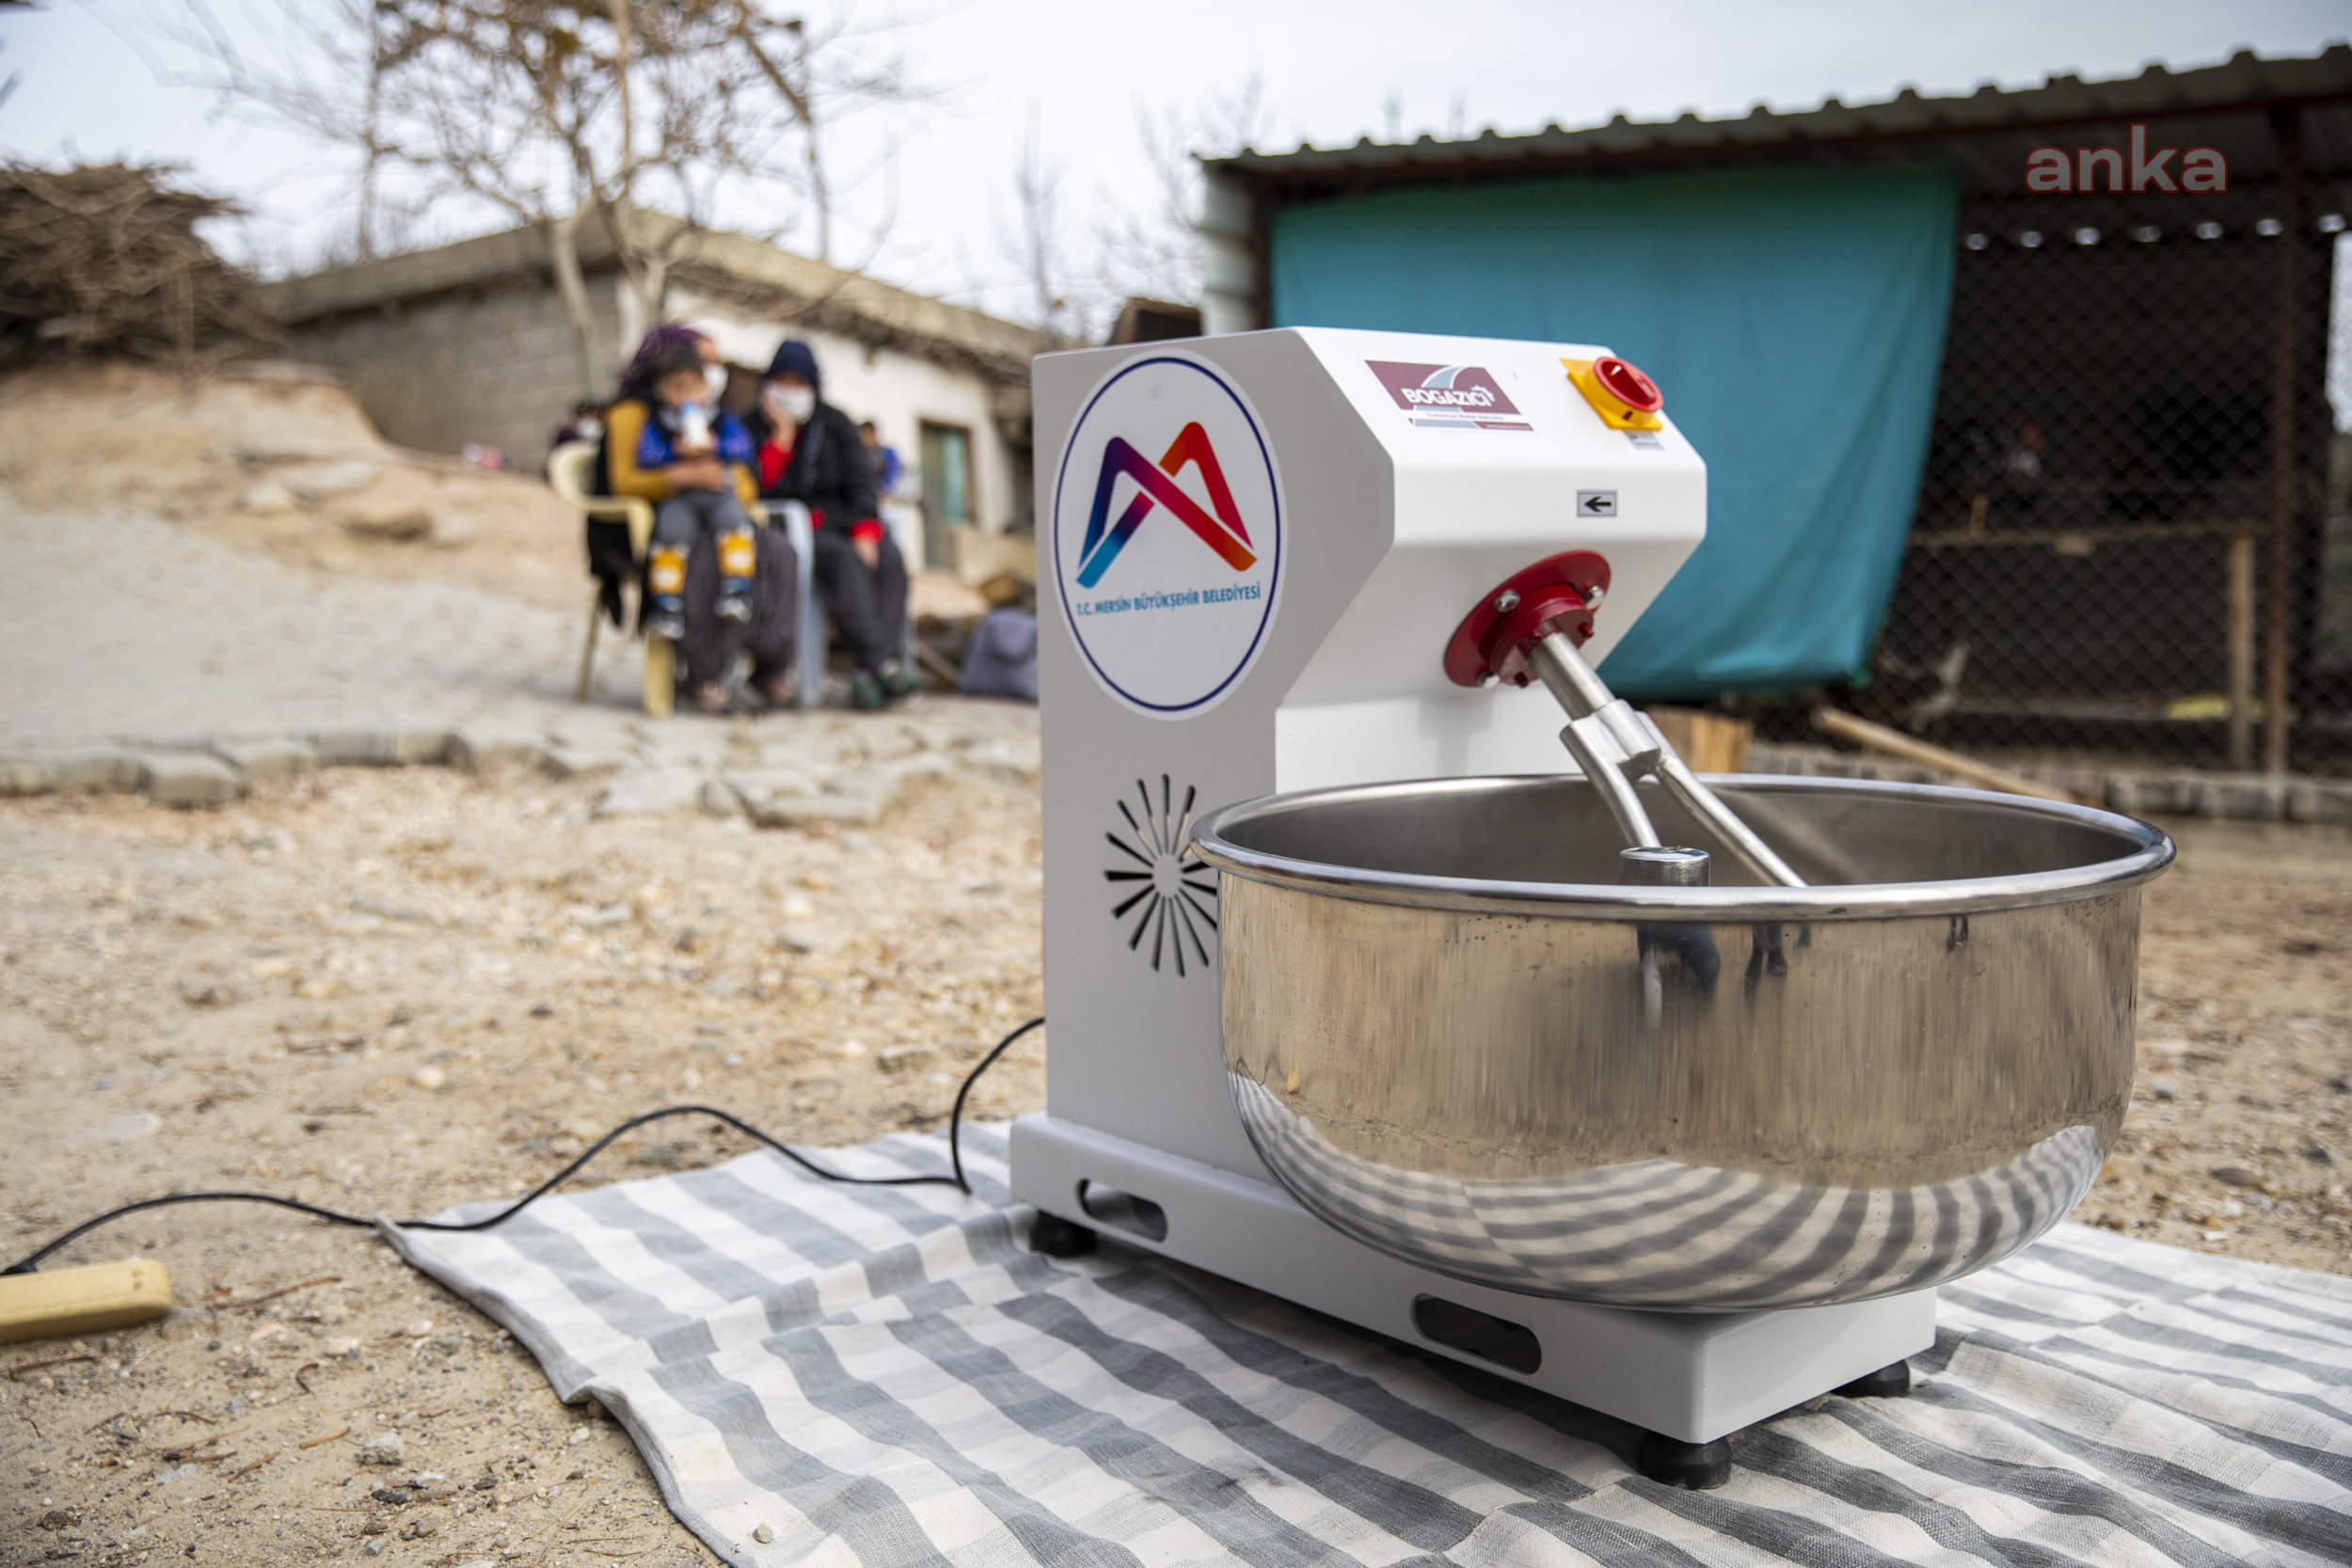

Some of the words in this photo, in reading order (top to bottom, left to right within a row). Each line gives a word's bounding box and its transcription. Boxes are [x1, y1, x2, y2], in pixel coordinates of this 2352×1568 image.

[1076, 602, 1092, 617] T.C.
[1134, 588, 1200, 611] BÜYÜKŞEHİR
[1202, 580, 1262, 604] BELEDİYESİ
